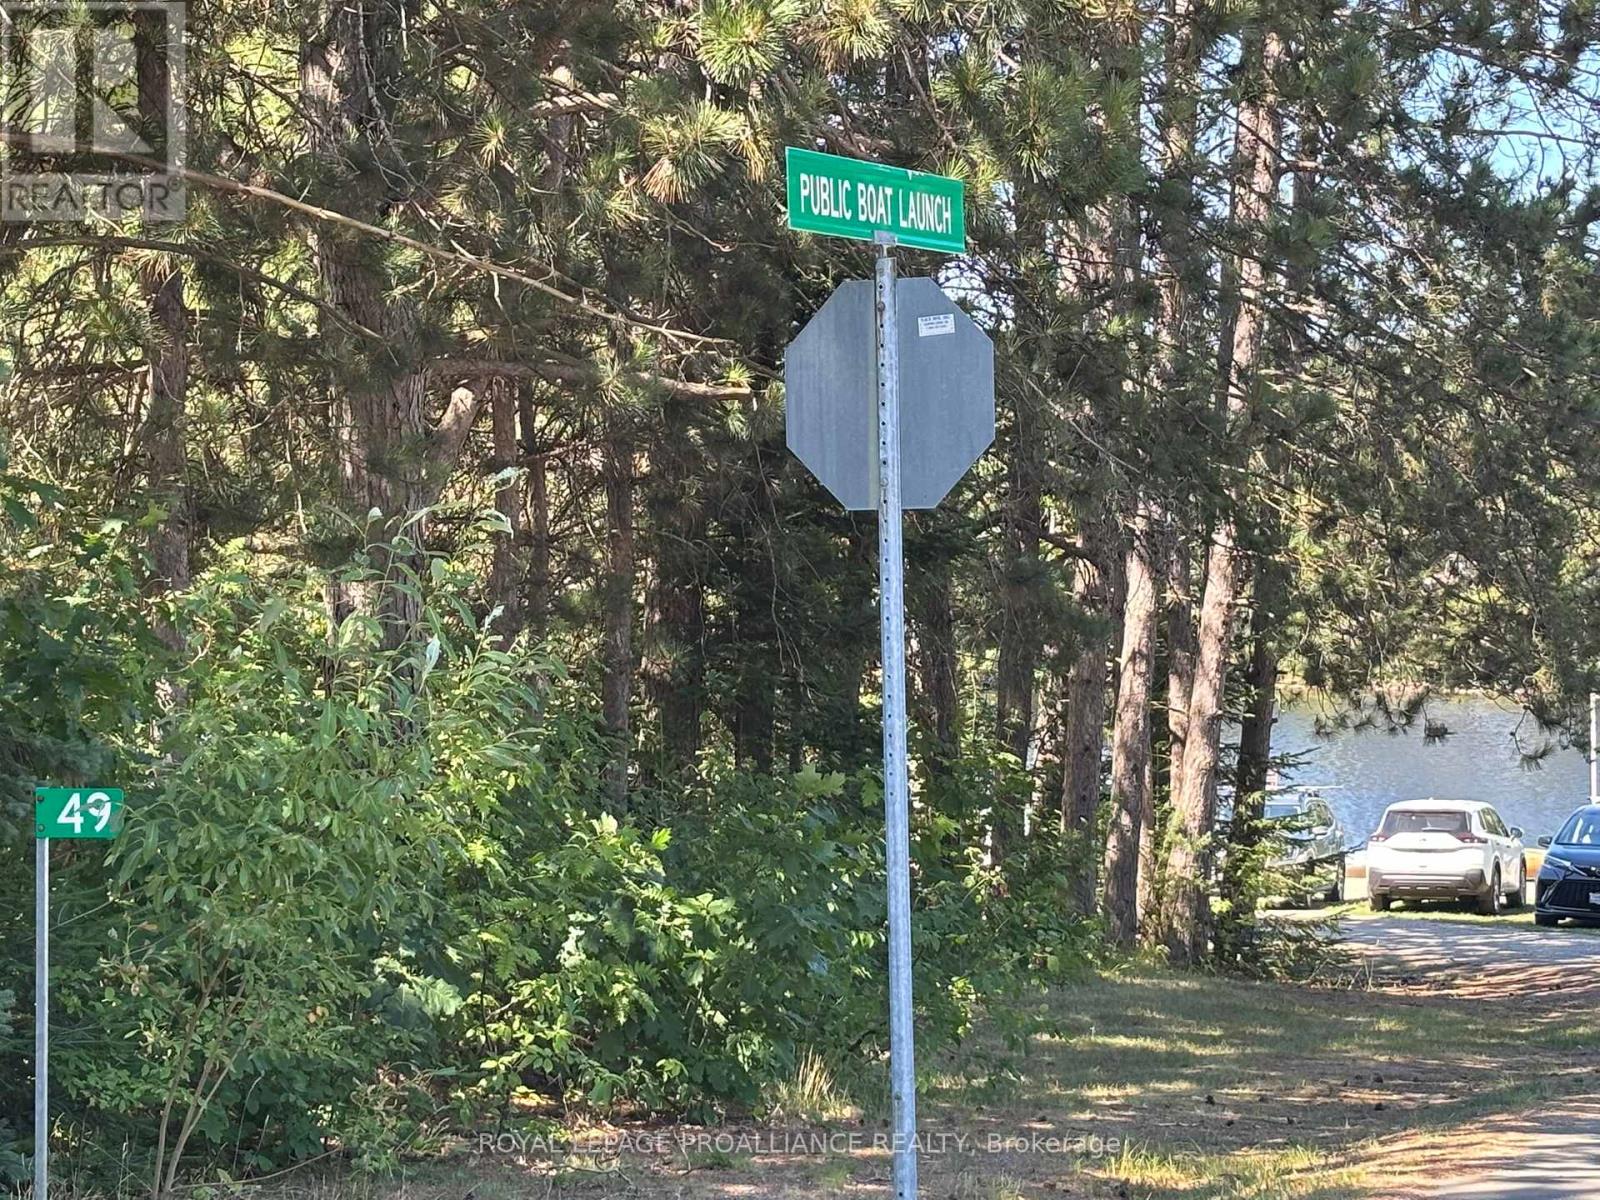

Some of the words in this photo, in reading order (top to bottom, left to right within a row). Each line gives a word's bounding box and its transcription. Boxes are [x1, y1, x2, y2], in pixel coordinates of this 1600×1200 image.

[799, 173, 852, 221] PUBLIC
[857, 182, 893, 226] BOAT
[899, 188, 952, 234] LAUNCH
[57, 791, 111, 834] 49
